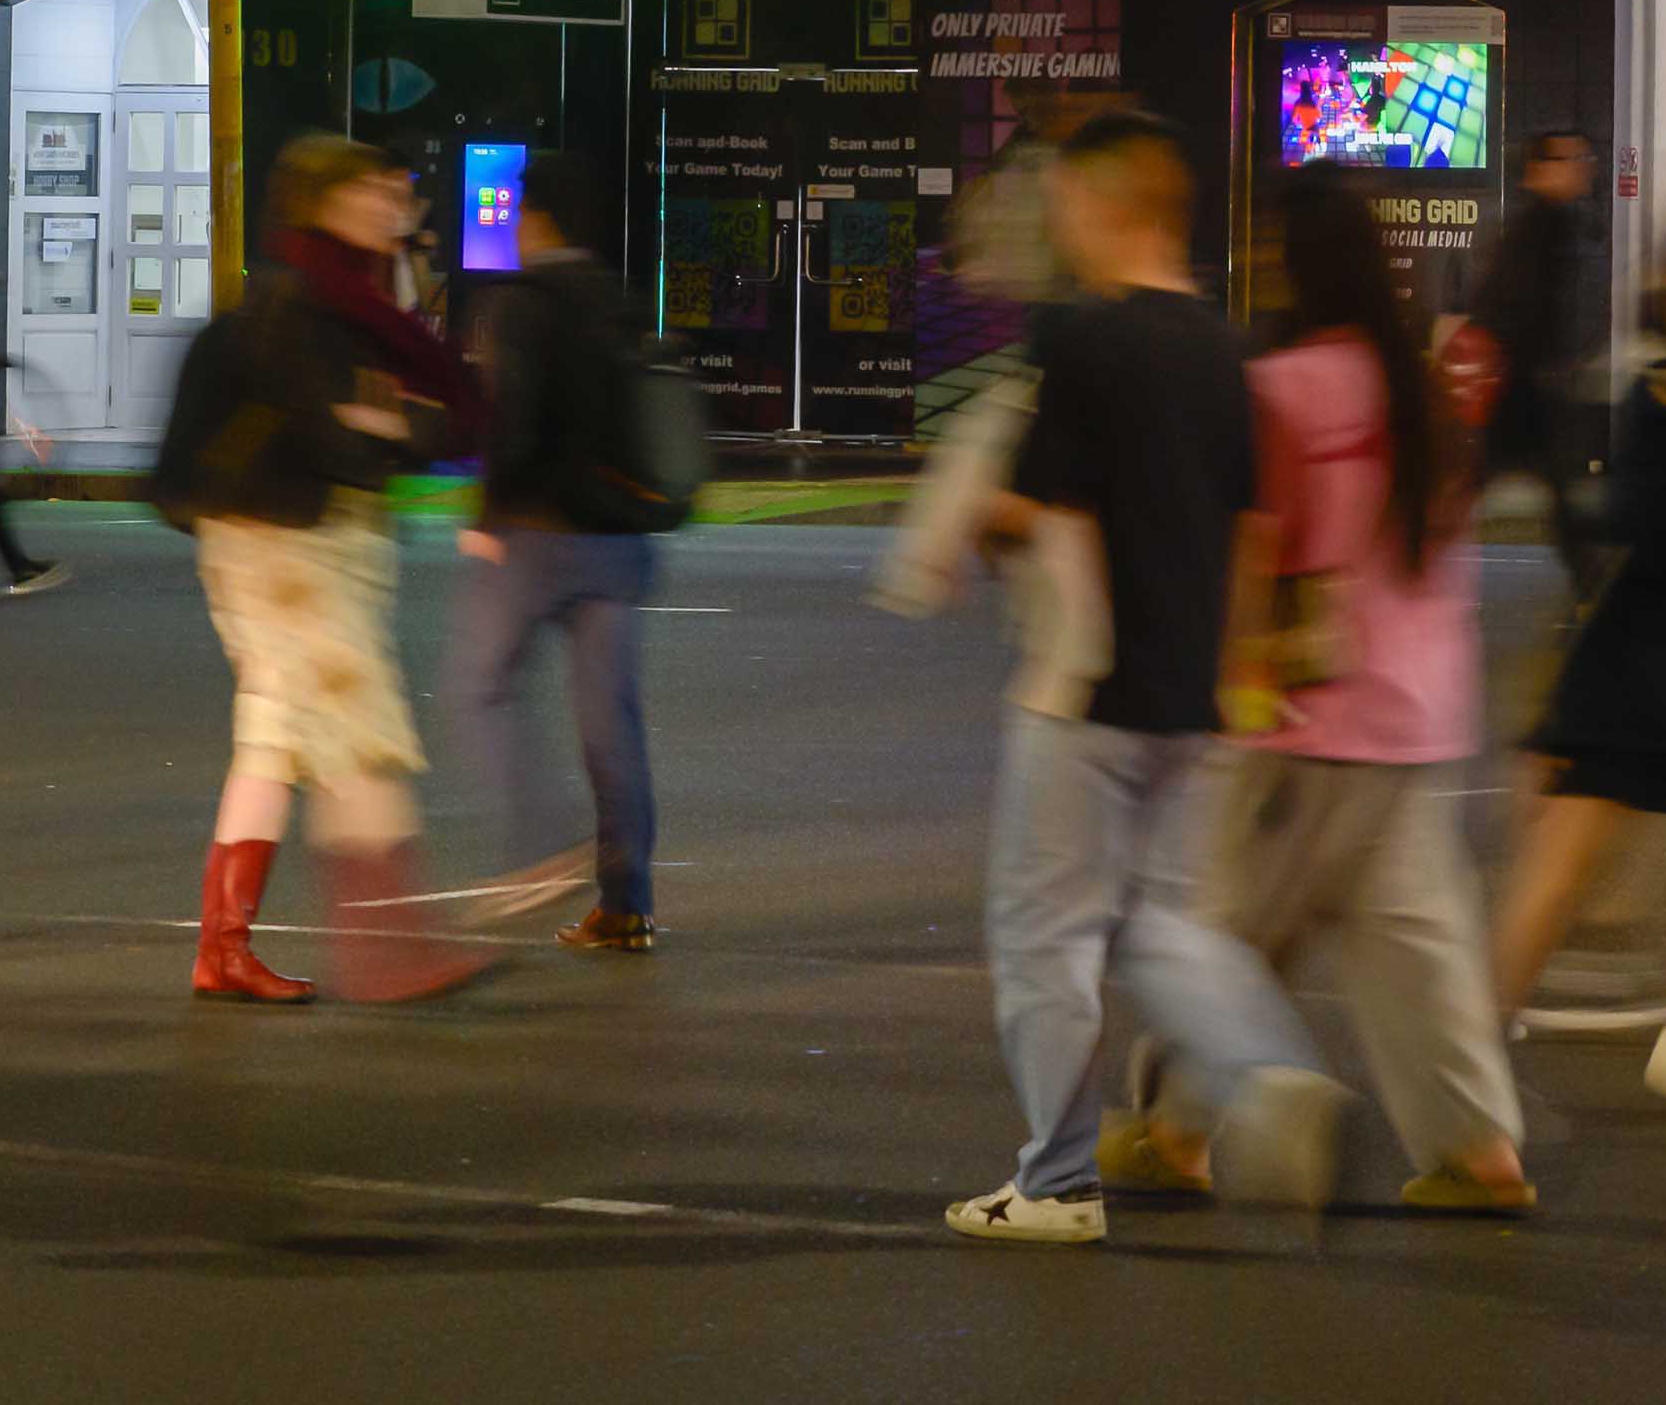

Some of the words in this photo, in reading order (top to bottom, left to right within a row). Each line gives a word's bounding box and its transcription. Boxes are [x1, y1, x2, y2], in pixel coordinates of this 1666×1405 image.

[931, 12, 984, 38] ONLY
[984, 12, 1067, 38] PRIVATE
[930, 52, 1045, 78] IMMERSIVE
[1047, 52, 1121, 79] GAMIN
[736, 71, 781, 93] GRID
[729, 135, 769, 150] Book
[828, 136, 868, 151] Scan
[870, 136, 900, 151] and
[684, 162, 727, 177] Game
[732, 161, 784, 179] Today!
[817, 164, 854, 179] Your
[858, 164, 905, 179] Game
[1426, 198, 1479, 225] GRID
[1382, 229, 1425, 247] SOCIAL
[1426, 230, 1473, 248] MEDIA!
[699, 355, 734, 368] visit
[858, 359, 874, 371] or
[878, 357, 913, 371] visit
